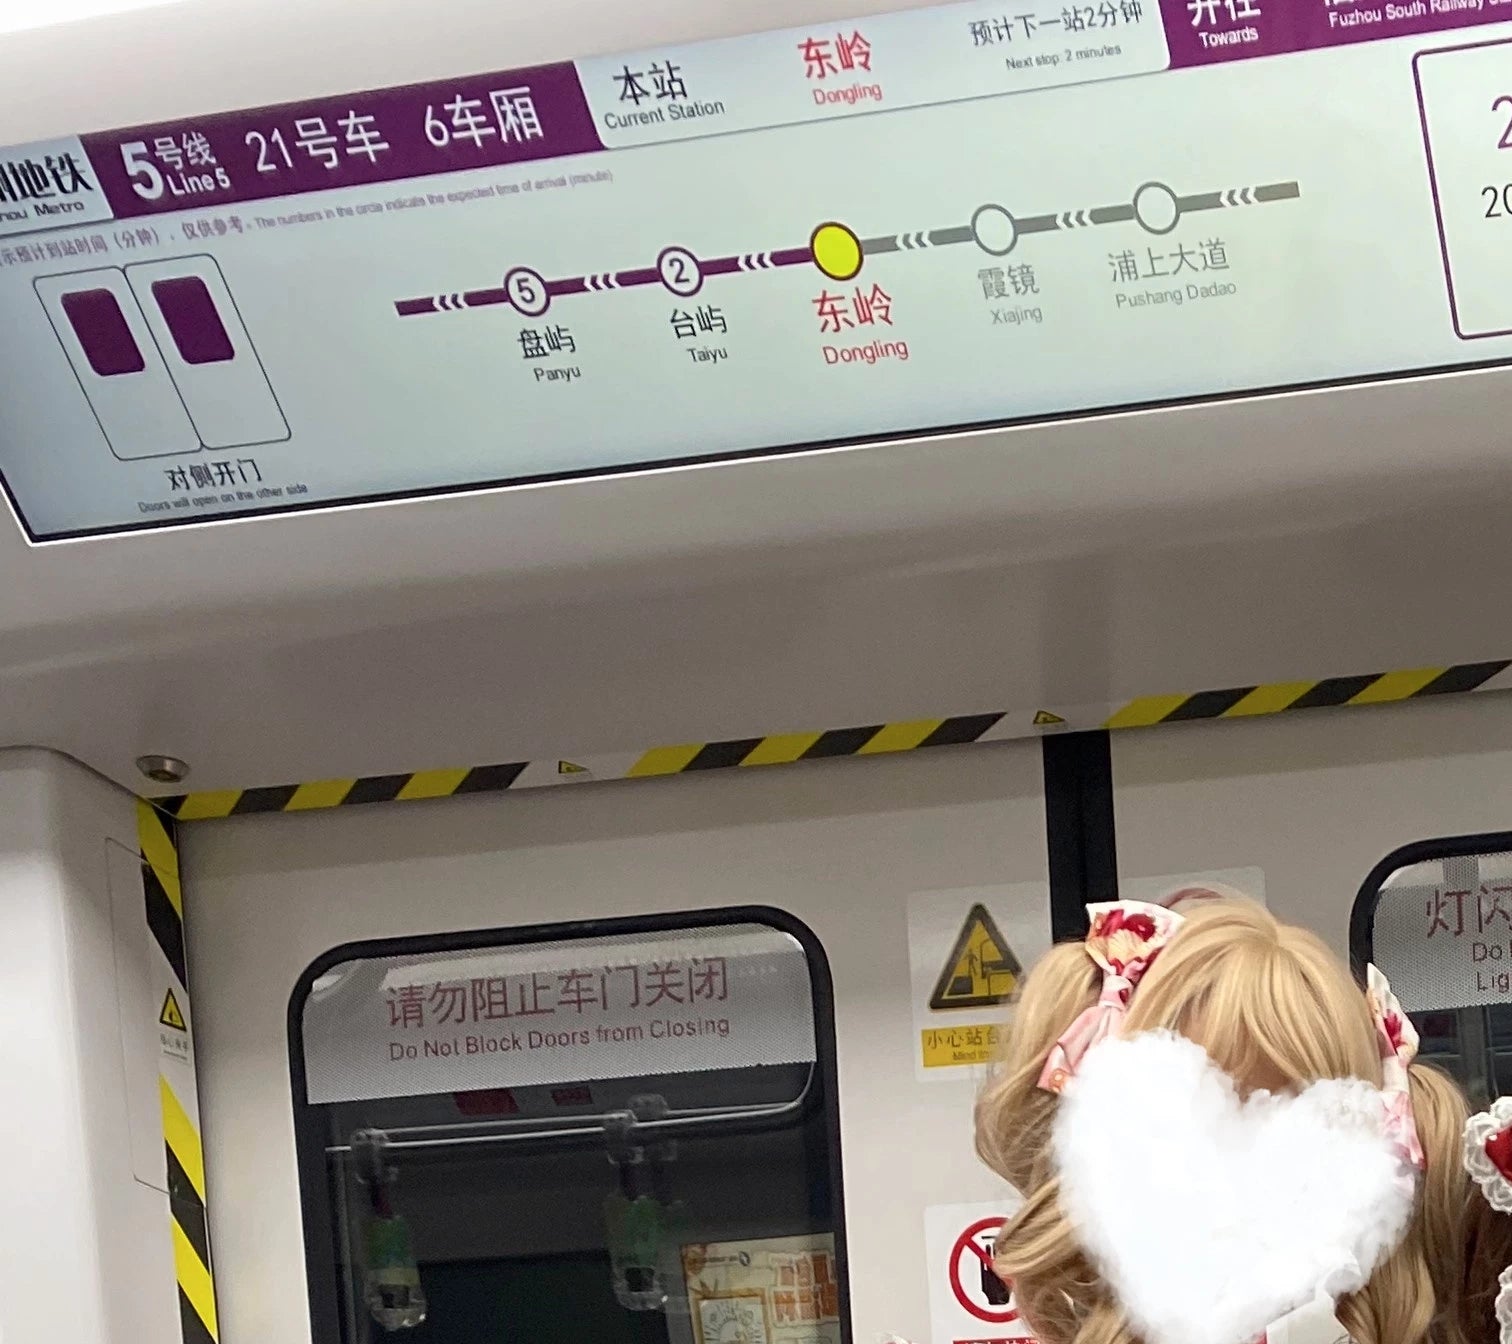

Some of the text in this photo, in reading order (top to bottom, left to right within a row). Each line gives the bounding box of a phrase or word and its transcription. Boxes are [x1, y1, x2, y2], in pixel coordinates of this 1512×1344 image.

[968, 0, 1142, 46] 预计下一站2分钟
[1329, 10, 1382, 27] Fuzhou
[1385, 3, 1426, 20] South
[1199, 25, 1258, 48] Towards
[798, 31, 872, 80] 东岭
[1006, 56, 1033, 70] Next
[1066, 50, 1073, 61] 2
[1076, 45, 1121, 59] minutes
[614, 61, 687, 104] 本站
[813, 81, 882, 105] Dongling
[425, 86, 544, 149] 6车厢
[605, 99, 724, 129] Current Station
[245, 111, 389, 172] 21号车
[33, 202, 84, 216] Metro
[669, 257, 687, 283] 2
[1108, 239, 1229, 283] 浦上大道
[517, 276, 536, 304] 5
[977, 264, 1039, 300] 霞镜
[1115, 280, 1236, 311] Pushang Dadao
[669, 306, 728, 338] 台屿
[812, 283, 892, 335] 东岭
[990, 304, 1043, 324] Xiajing
[517, 324, 577, 360] 盘屿
[687, 344, 728, 364] Taiyu
[822, 338, 908, 365] Dongling
[533, 365, 581, 383] Panyu
[164, 458, 262, 491] 对侧开门
[1472, 940, 1503, 963] Do
[387, 957, 728, 1029] 请勿阻止车门关闭
[390, 1015, 730, 1061] Do Not Block Doors from Closing
